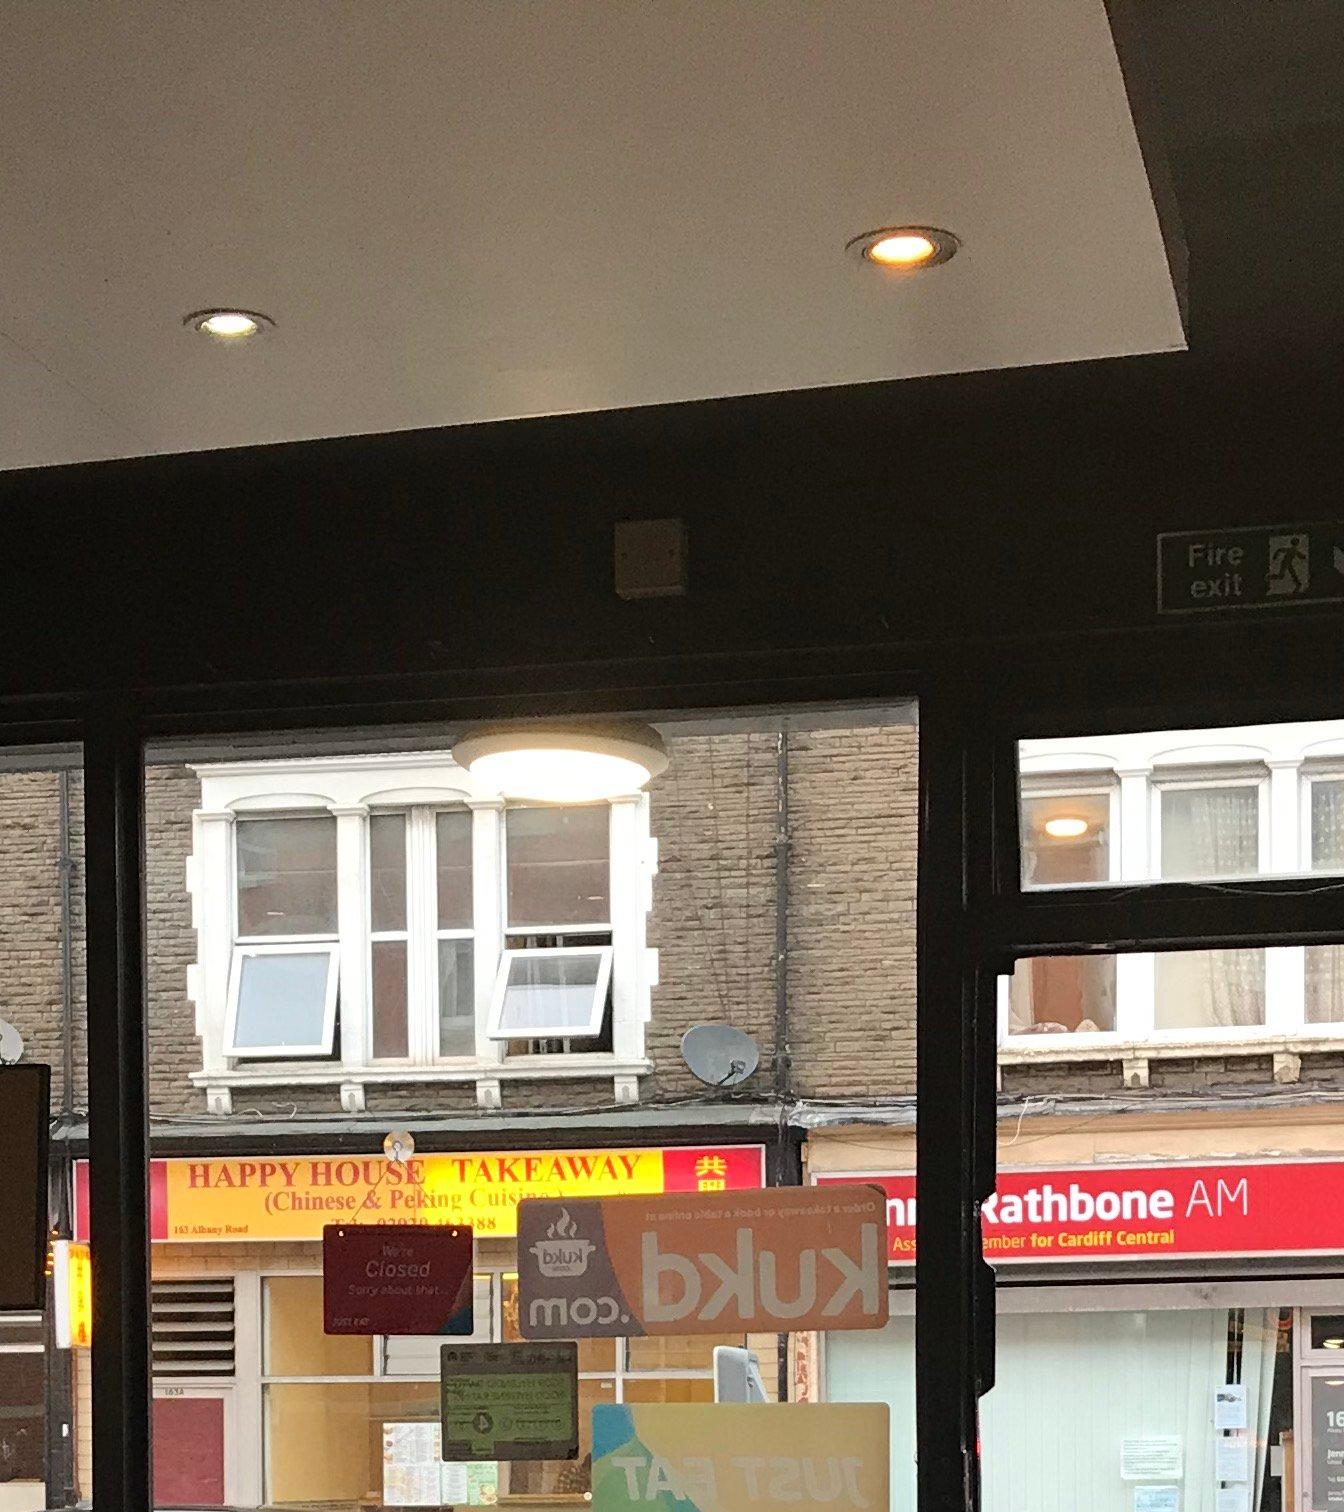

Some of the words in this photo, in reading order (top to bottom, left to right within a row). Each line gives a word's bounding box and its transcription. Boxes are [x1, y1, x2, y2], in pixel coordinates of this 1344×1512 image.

[1187, 543, 1244, 568] Fire
[1189, 573, 1244, 599] exit
[186, 1162, 301, 1189] HAPPY
[309, 1159, 426, 1187] HOUSE
[451, 1153, 642, 1183] TAKEAWAY
[264, 1189, 358, 1216] (Chinese
[362, 1189, 382, 1210] &
[389, 1189, 462, 1211] Peking
[1184, 1177, 1249, 1218] AM
[225, 1224, 249, 1234] Road
[982, 1233, 1025, 1250] ember
[1030, 1232, 1054, 1248] for
[1057, 1230, 1113, 1248] Cardiff
[1116, 1228, 1175, 1246] Central
[365, 1260, 431, 1278] Closed
[348, 1284, 378, 1297] Sorry
[380, 1284, 413, 1296] about
